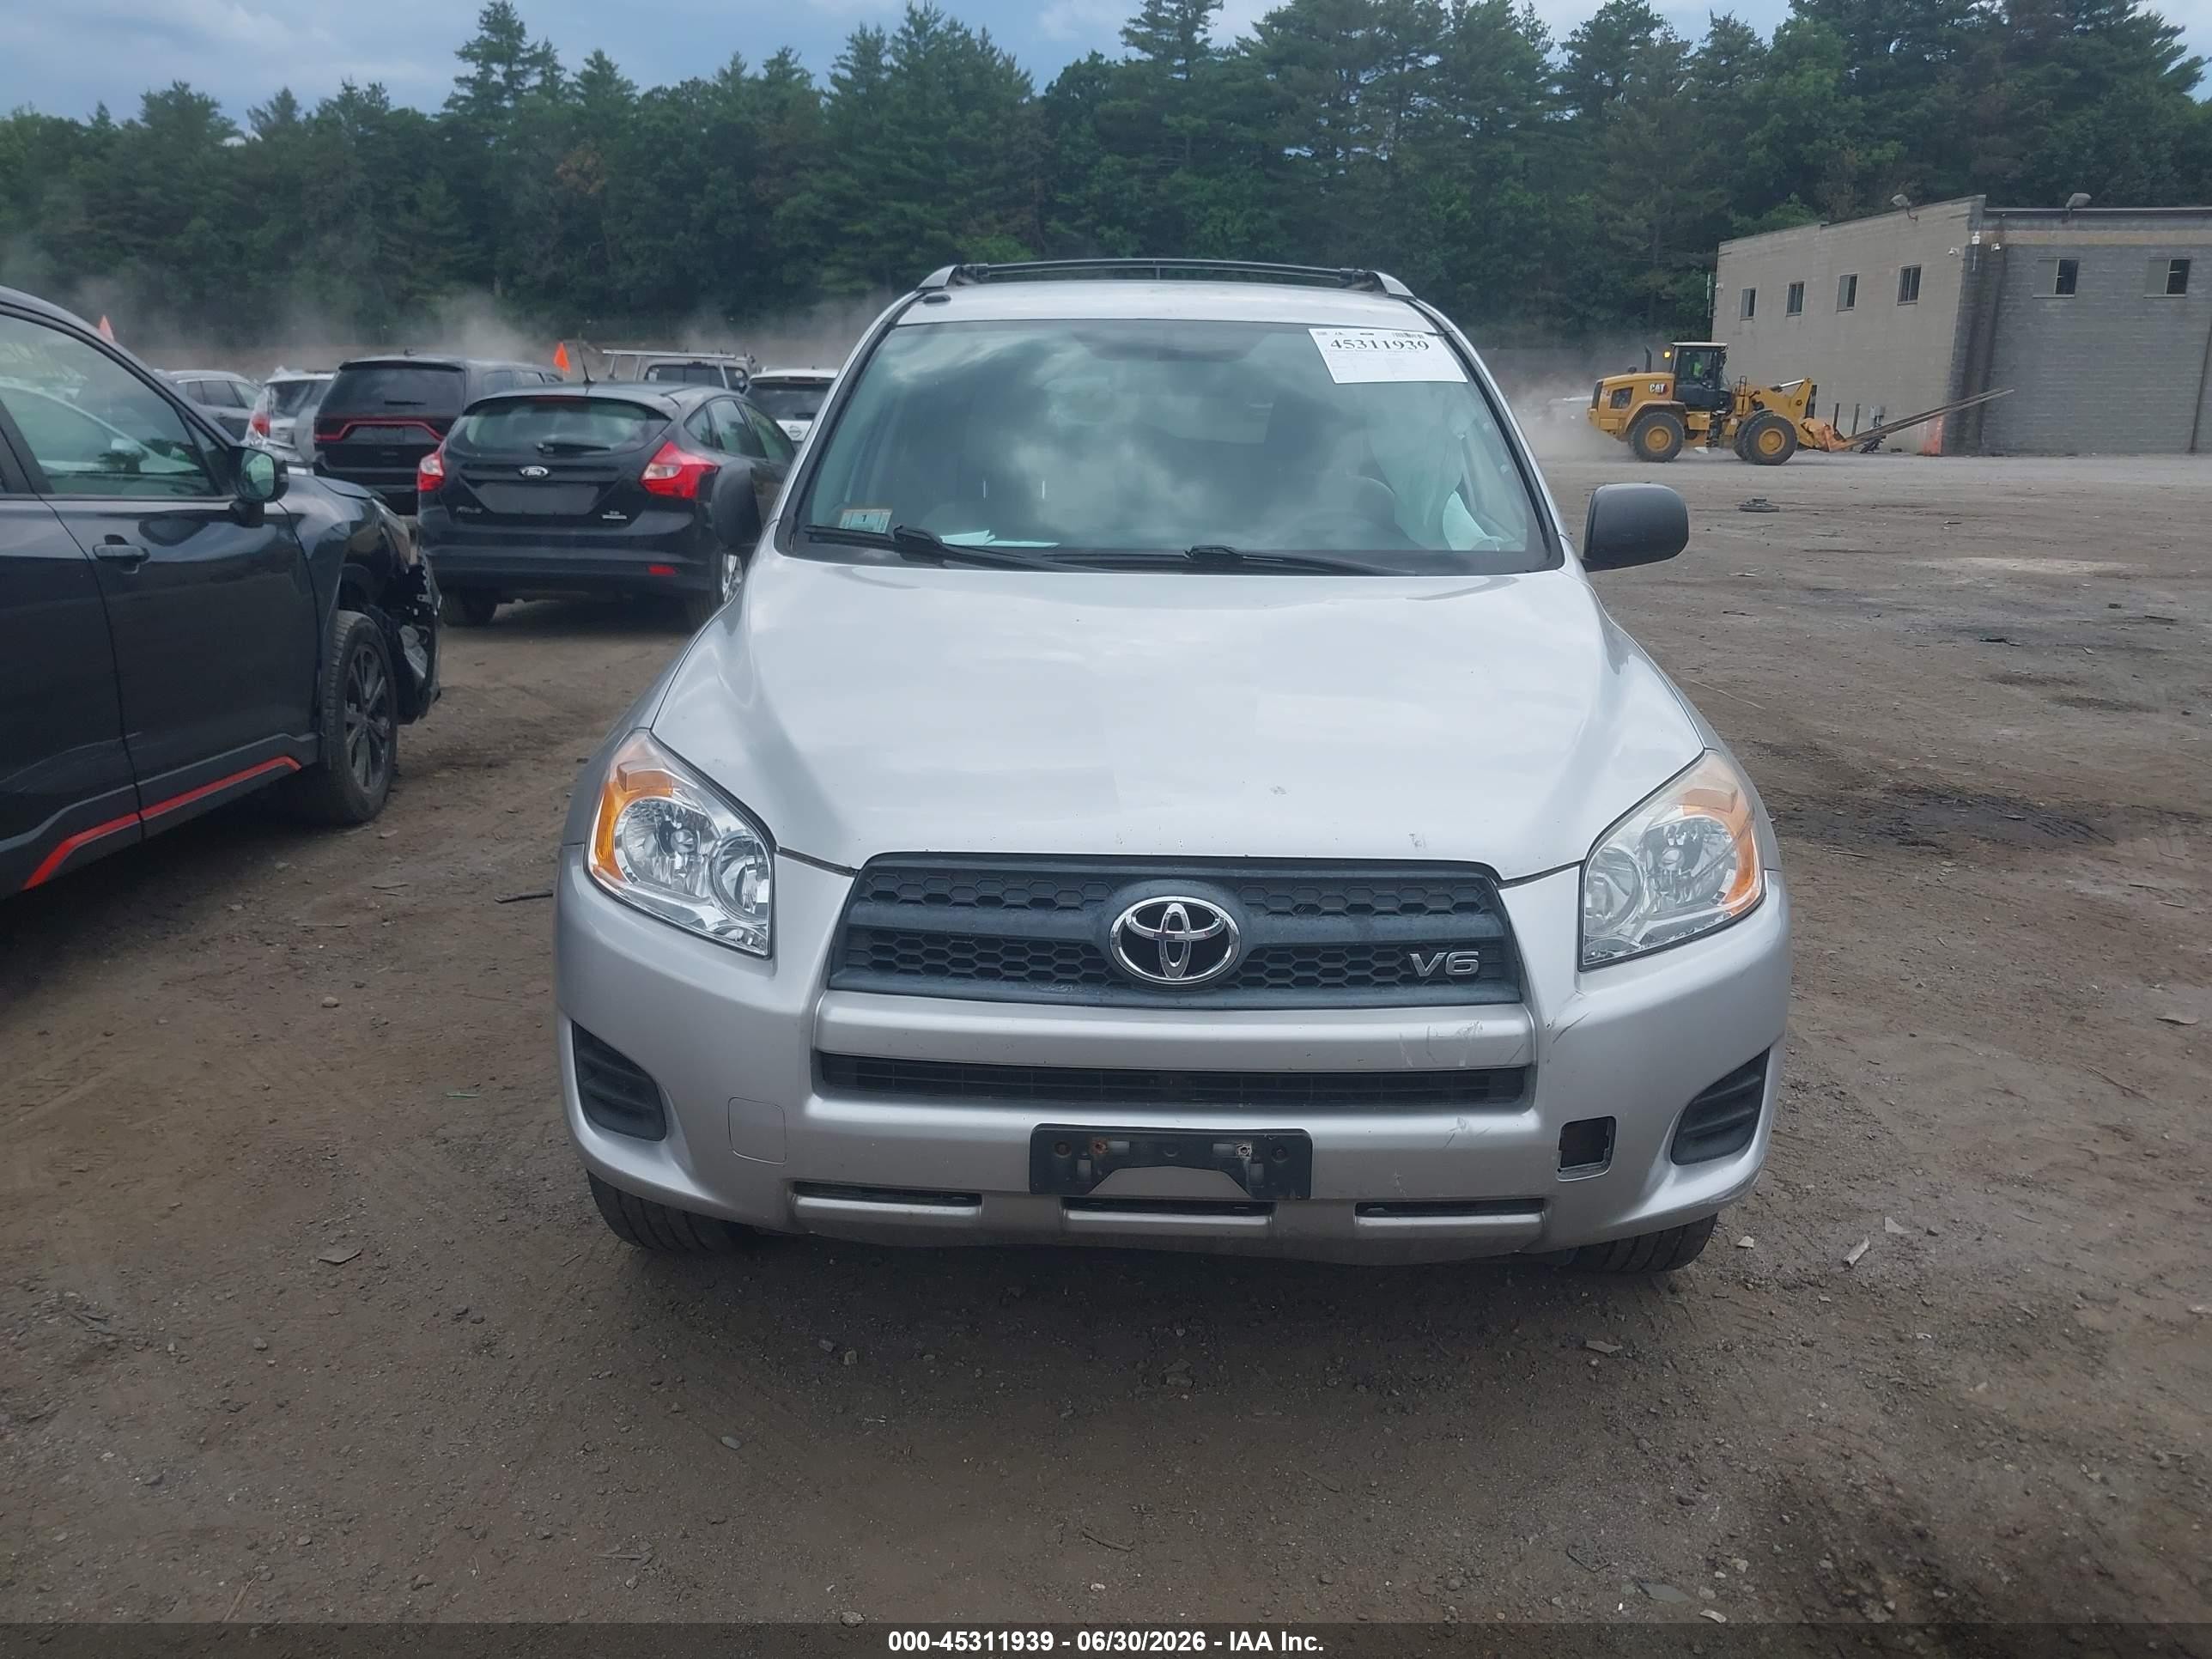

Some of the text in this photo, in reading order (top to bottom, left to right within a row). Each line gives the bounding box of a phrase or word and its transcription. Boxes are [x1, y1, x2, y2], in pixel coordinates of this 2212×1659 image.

[1330, 339, 1430, 350] 45311939
[1649, 383, 1666, 393] CAT
[1409, 951, 1479, 977] V6
